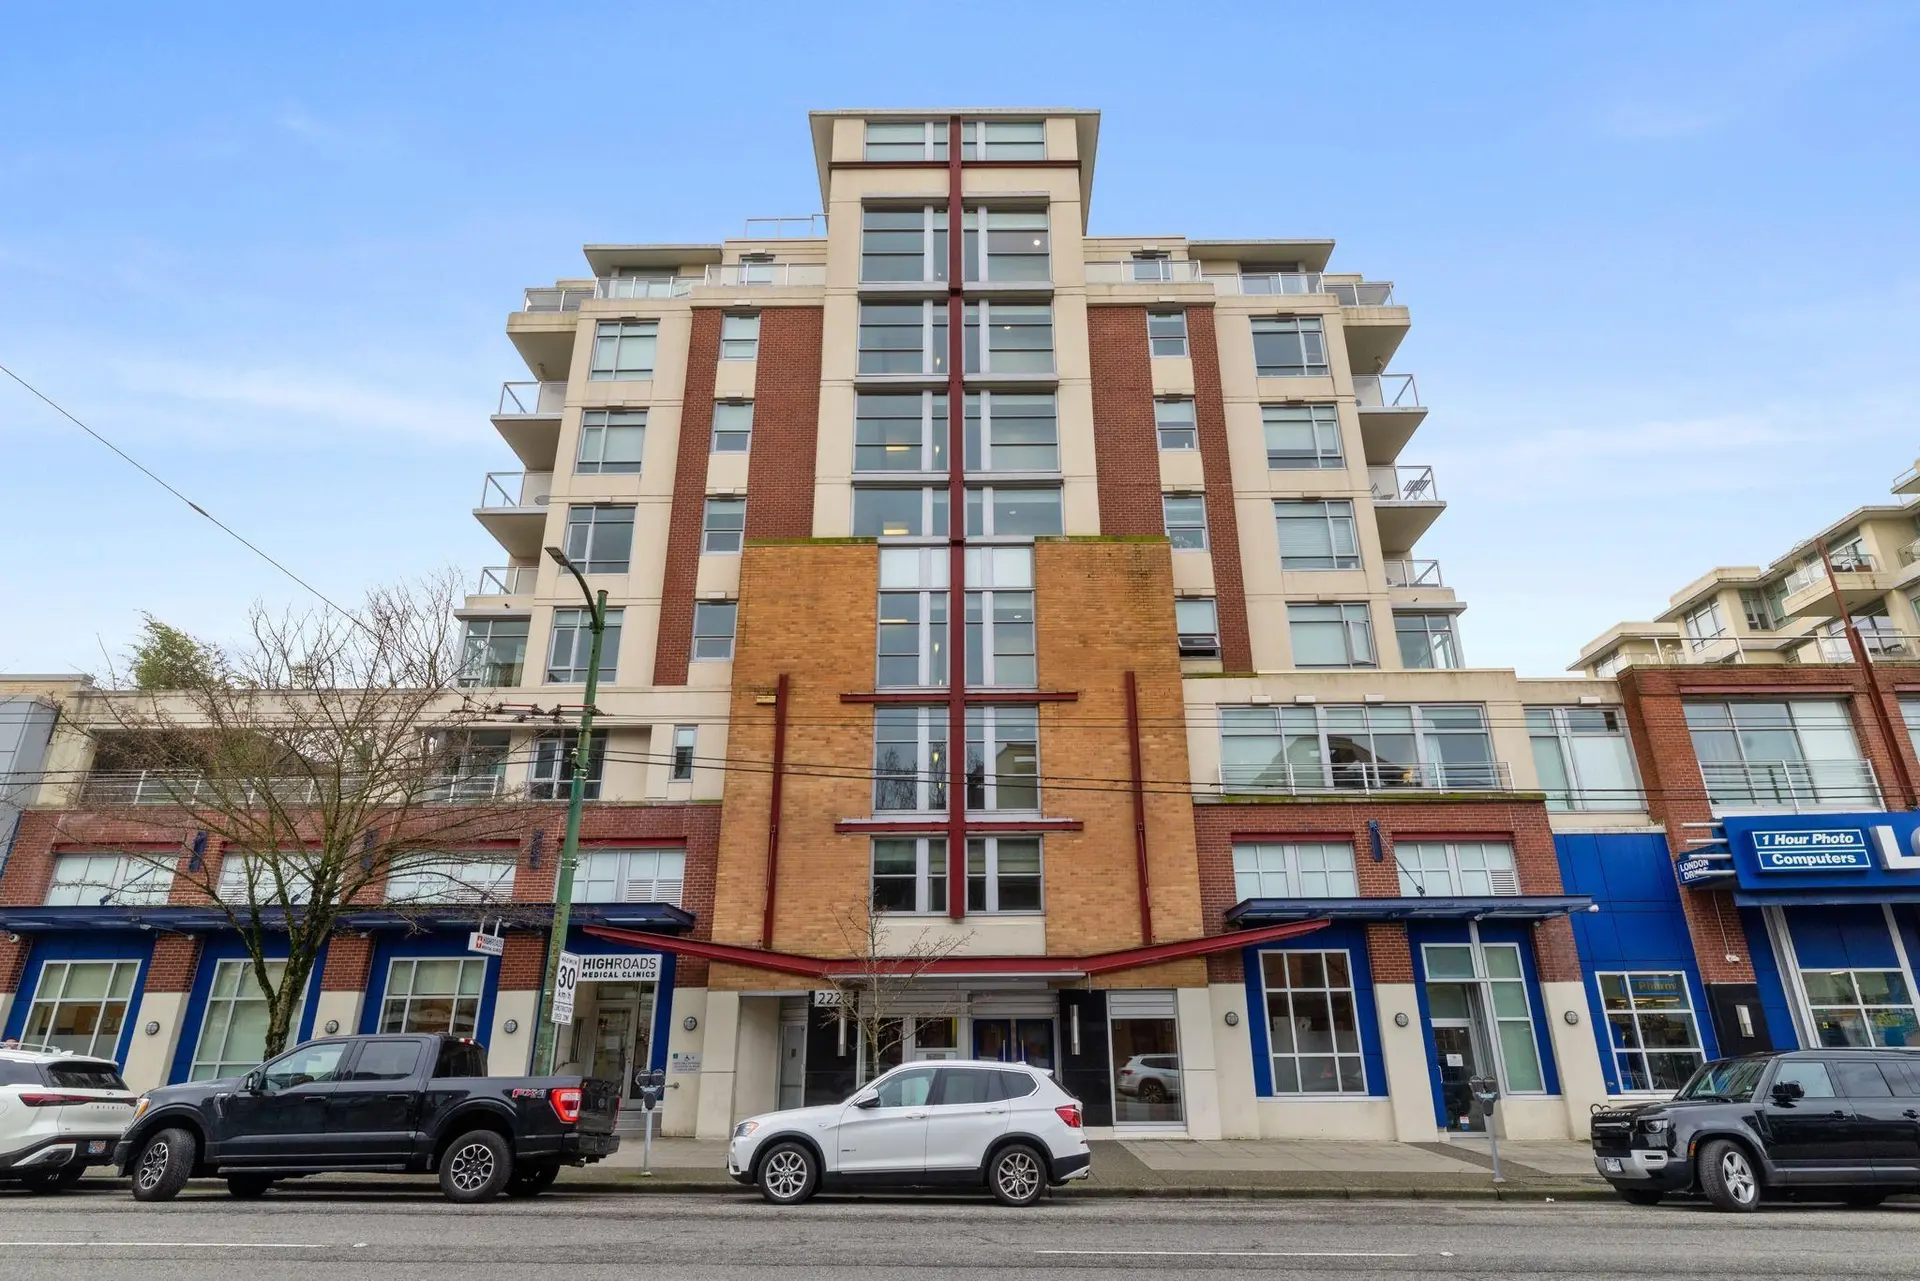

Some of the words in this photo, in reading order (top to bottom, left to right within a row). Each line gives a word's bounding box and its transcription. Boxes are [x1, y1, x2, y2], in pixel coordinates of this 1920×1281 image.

[1762, 834, 1770, 846] 1
[1774, 833, 1809, 846] Hour
[1812, 832, 1855, 845] Photo
[1869, 825, 1920, 870] L
[1679, 859, 1710, 873] LONDON
[1771, 852, 1857, 867] Computers
[582, 957, 657, 970] HIGHROADS
[558, 965, 576, 990] 30
